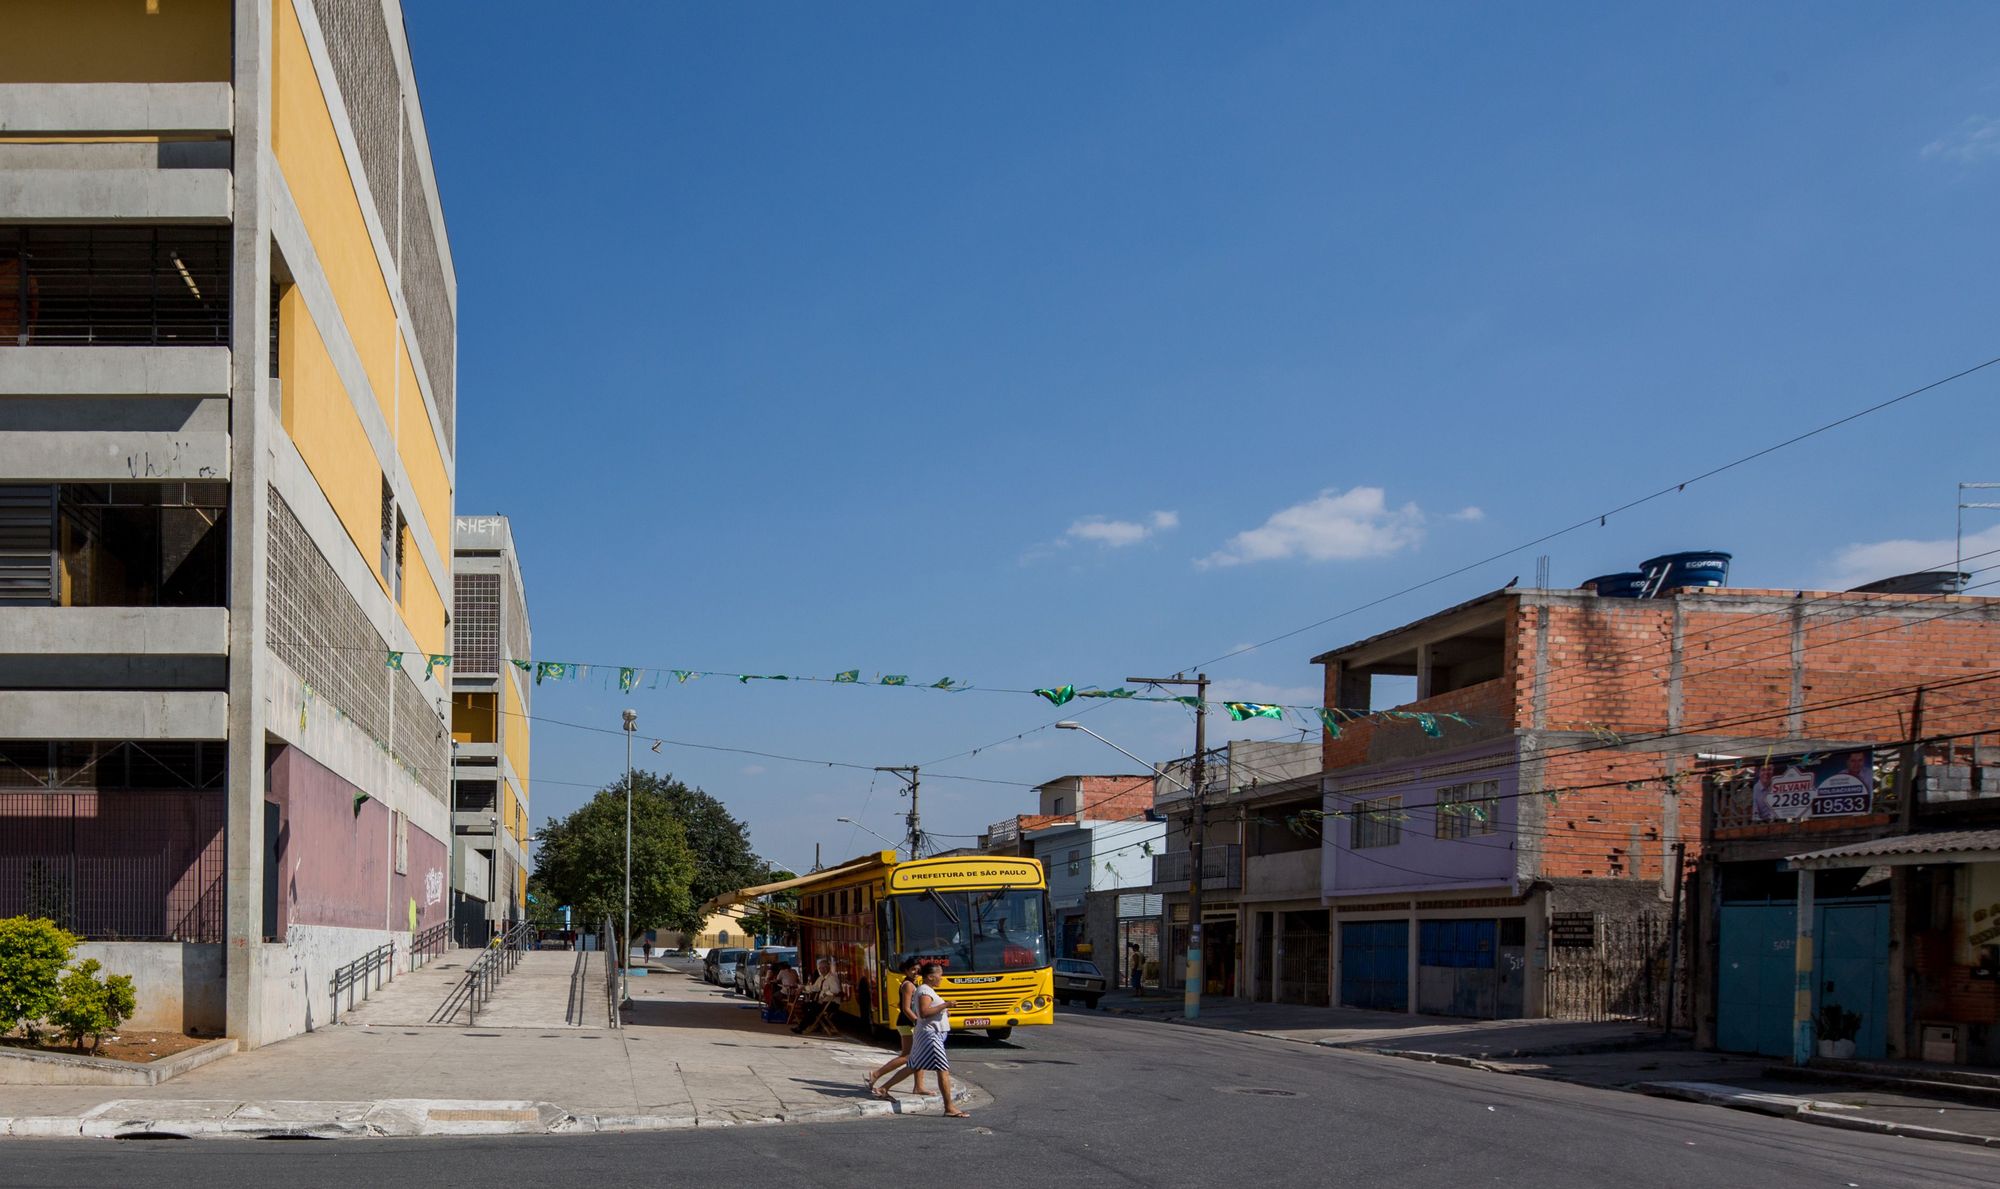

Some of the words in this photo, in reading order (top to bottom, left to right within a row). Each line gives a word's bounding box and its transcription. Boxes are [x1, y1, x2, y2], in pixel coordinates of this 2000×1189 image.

[1685, 560, 1723, 569] ECOFORTE
[1772, 782, 1811, 793] SILVANI
[1772, 792, 1811, 808] 2288
[1814, 797, 1865, 814] 19533
[911, 871, 964, 880] PREFEITURA
[980, 868, 997, 877] SÃO
[953, 976, 997, 984] BUSSCAR
